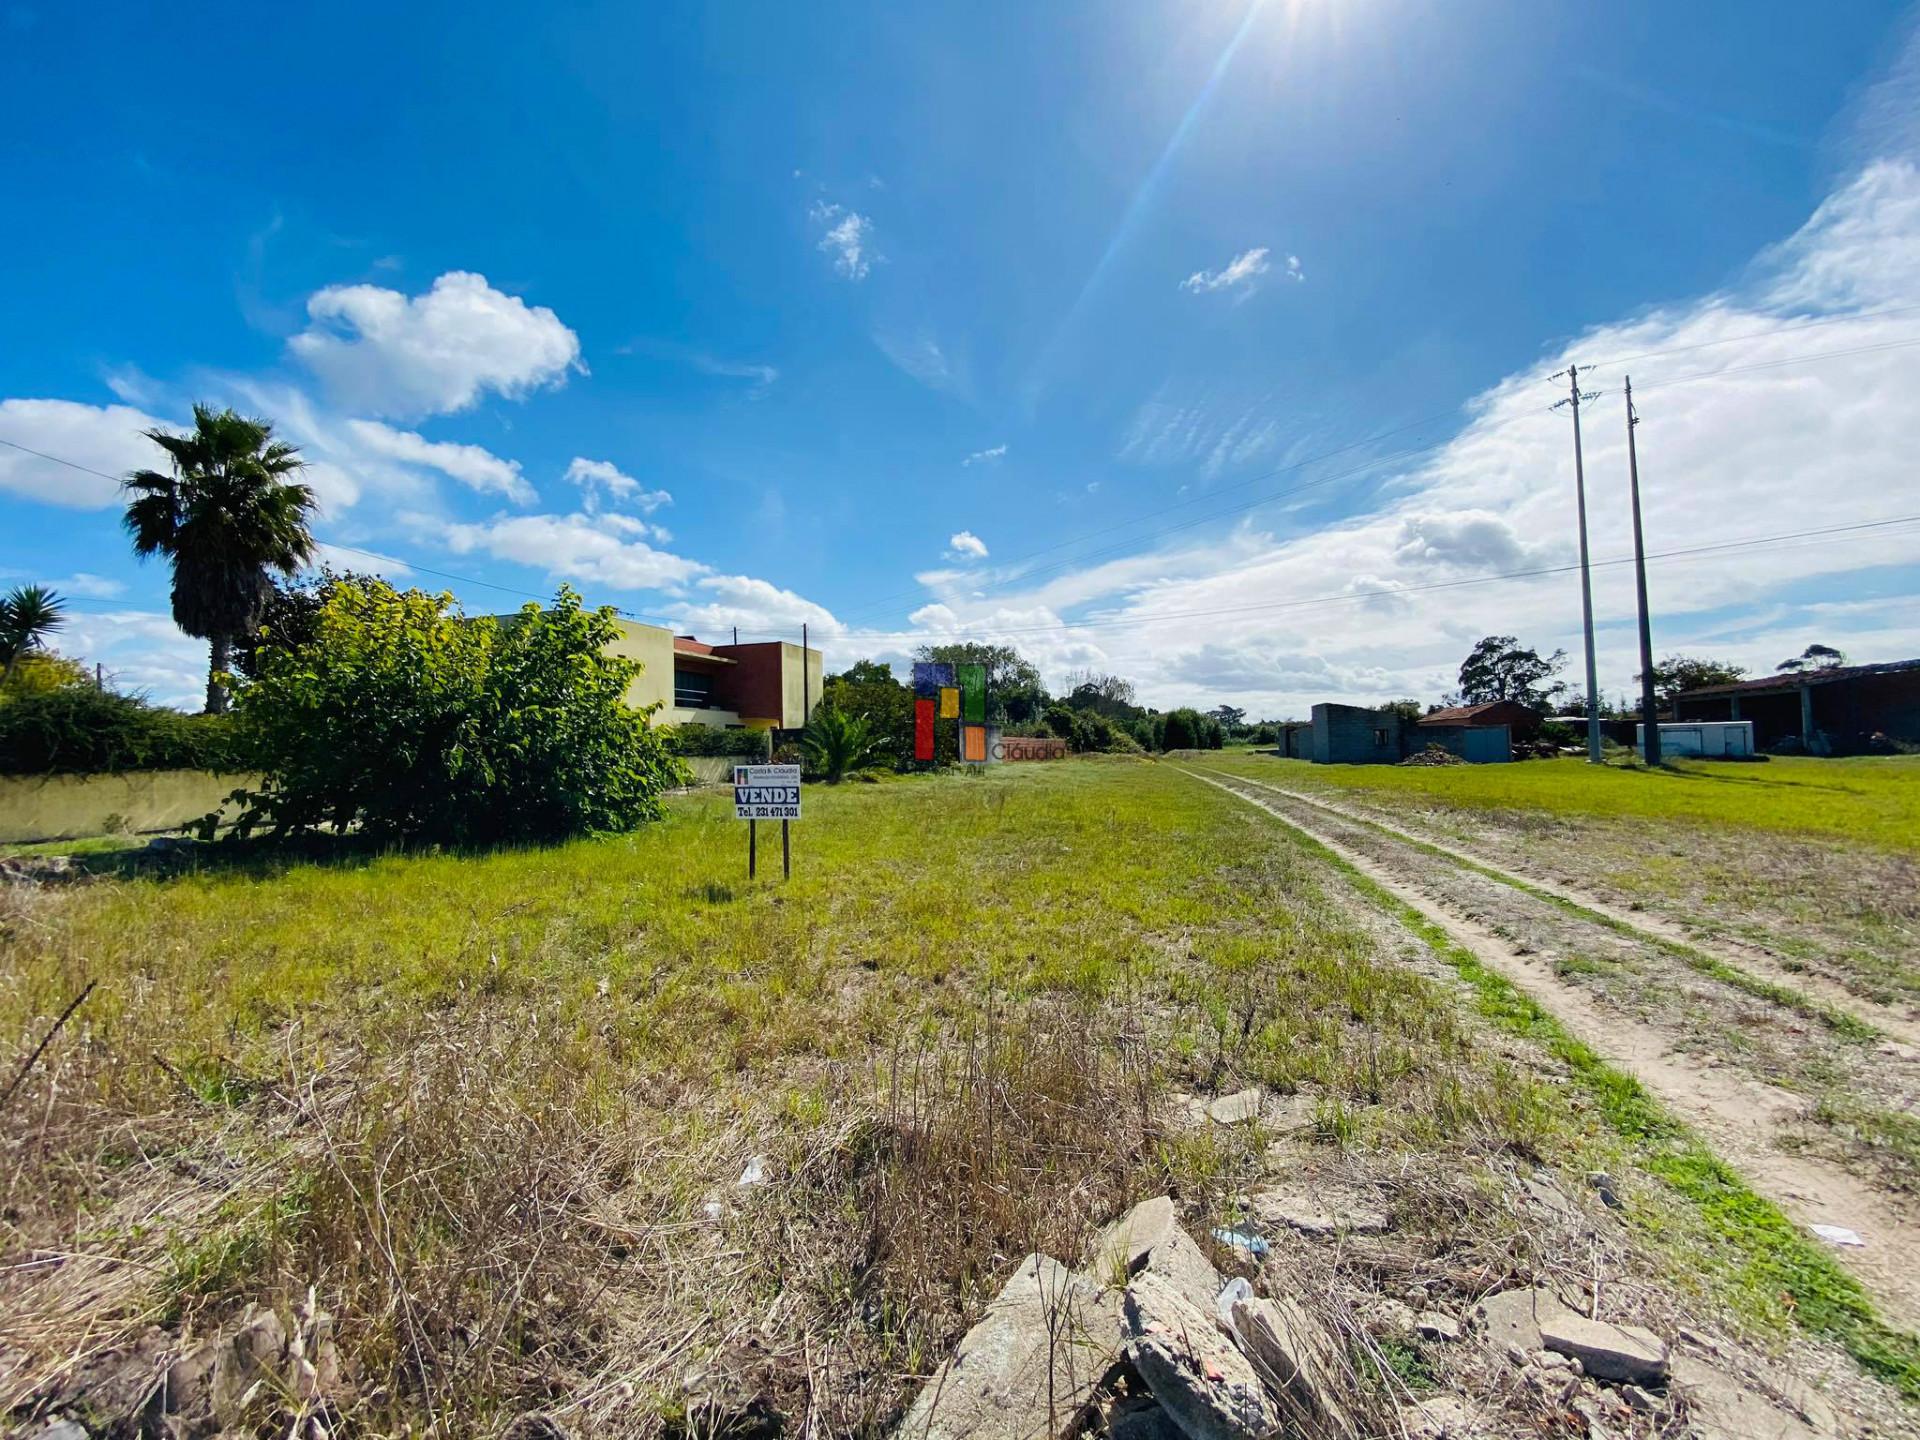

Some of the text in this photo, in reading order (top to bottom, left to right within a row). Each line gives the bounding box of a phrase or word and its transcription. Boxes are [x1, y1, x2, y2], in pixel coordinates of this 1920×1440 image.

[737, 788, 797, 803] VENDE
[738, 806, 798, 817] Tel. 231 471 301
